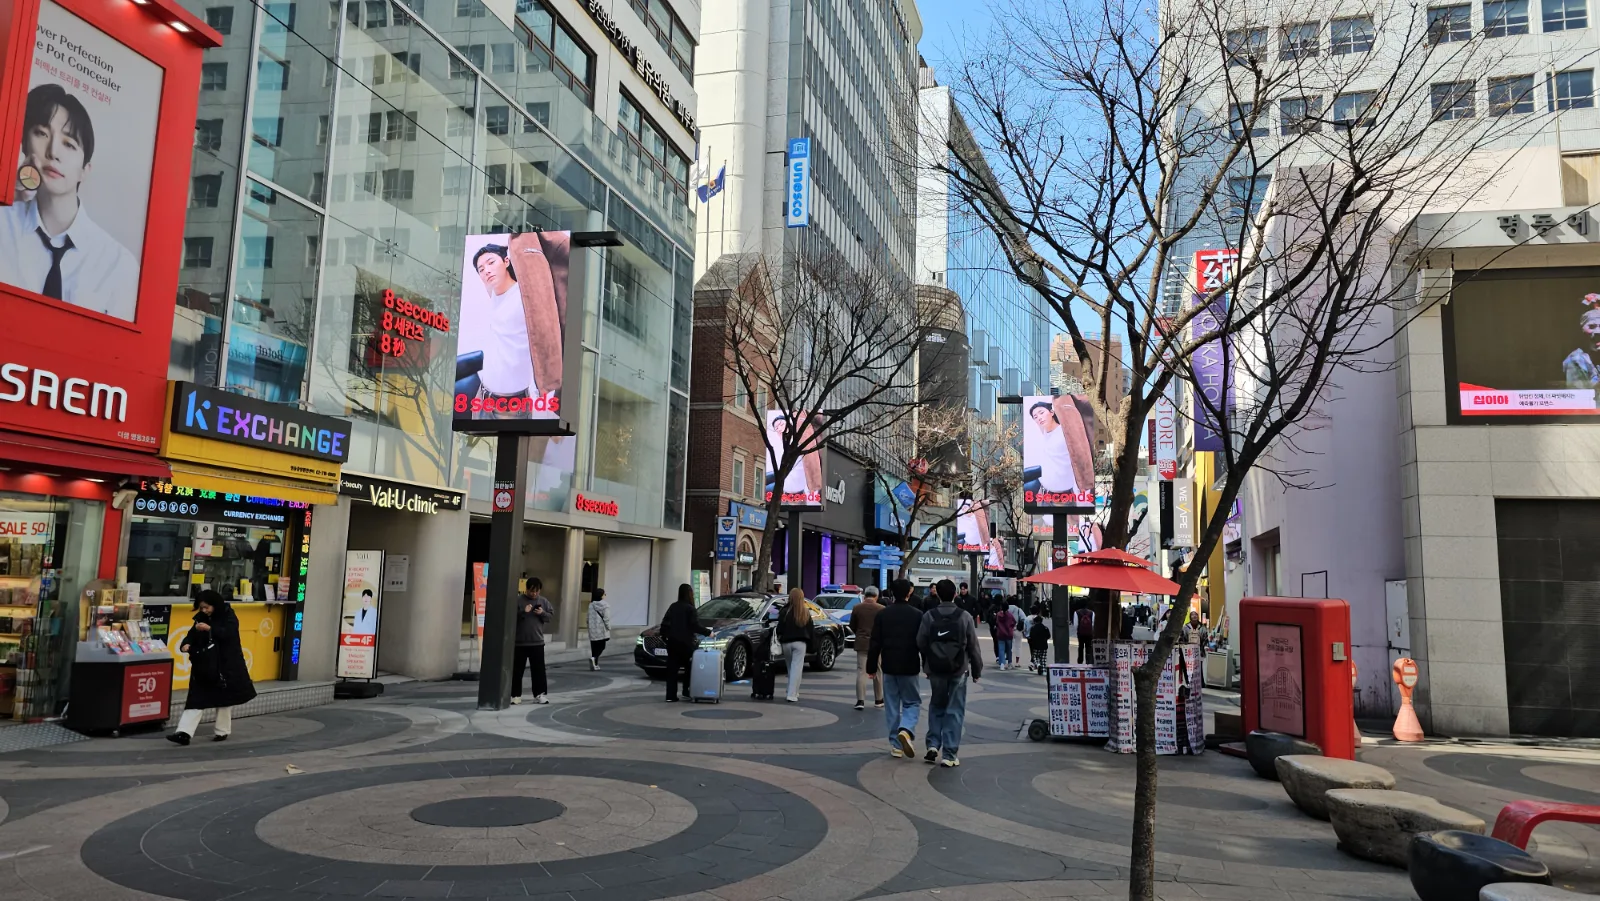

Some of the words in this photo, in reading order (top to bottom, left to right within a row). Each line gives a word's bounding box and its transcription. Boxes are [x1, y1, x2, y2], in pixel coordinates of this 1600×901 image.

[60, 34, 114, 73] Perfection
[46, 44, 65, 62] Pot
[67, 56, 121, 92] Concealer
[792, 162, 803, 218] unesco
[384, 289, 395, 309] 8
[395, 299, 450, 332] seconds
[382, 312, 394, 331] 8
[394, 316, 425, 342] 세컨즈
[381, 333, 392, 353] 8
[0, 363, 128, 423] SAEM
[454, 393, 468, 413] 8
[470, 392, 560, 413] seconds
[1473, 395, 1509, 405] 십이야
[216, 405, 347, 457] EXCHANGE
[407, 494, 438, 515] clinic
[452, 496, 461, 505] 4F
[575, 493, 584, 510] 8
[583, 496, 619, 517] seconds
[766, 492, 773, 502] 8
[780, 491, 821, 502] econds
[1024, 491, 1034, 502] 8
[1035, 490, 1094, 502] seconds
[223, 510, 254, 519] CURRENCY
[254, 513, 285, 523] EXCHANGE
[0, 521, 27, 535] SALE
[917, 556, 955, 566] SALOMON
[360, 636, 372, 645] 4F
[137, 677, 156, 693] 50
